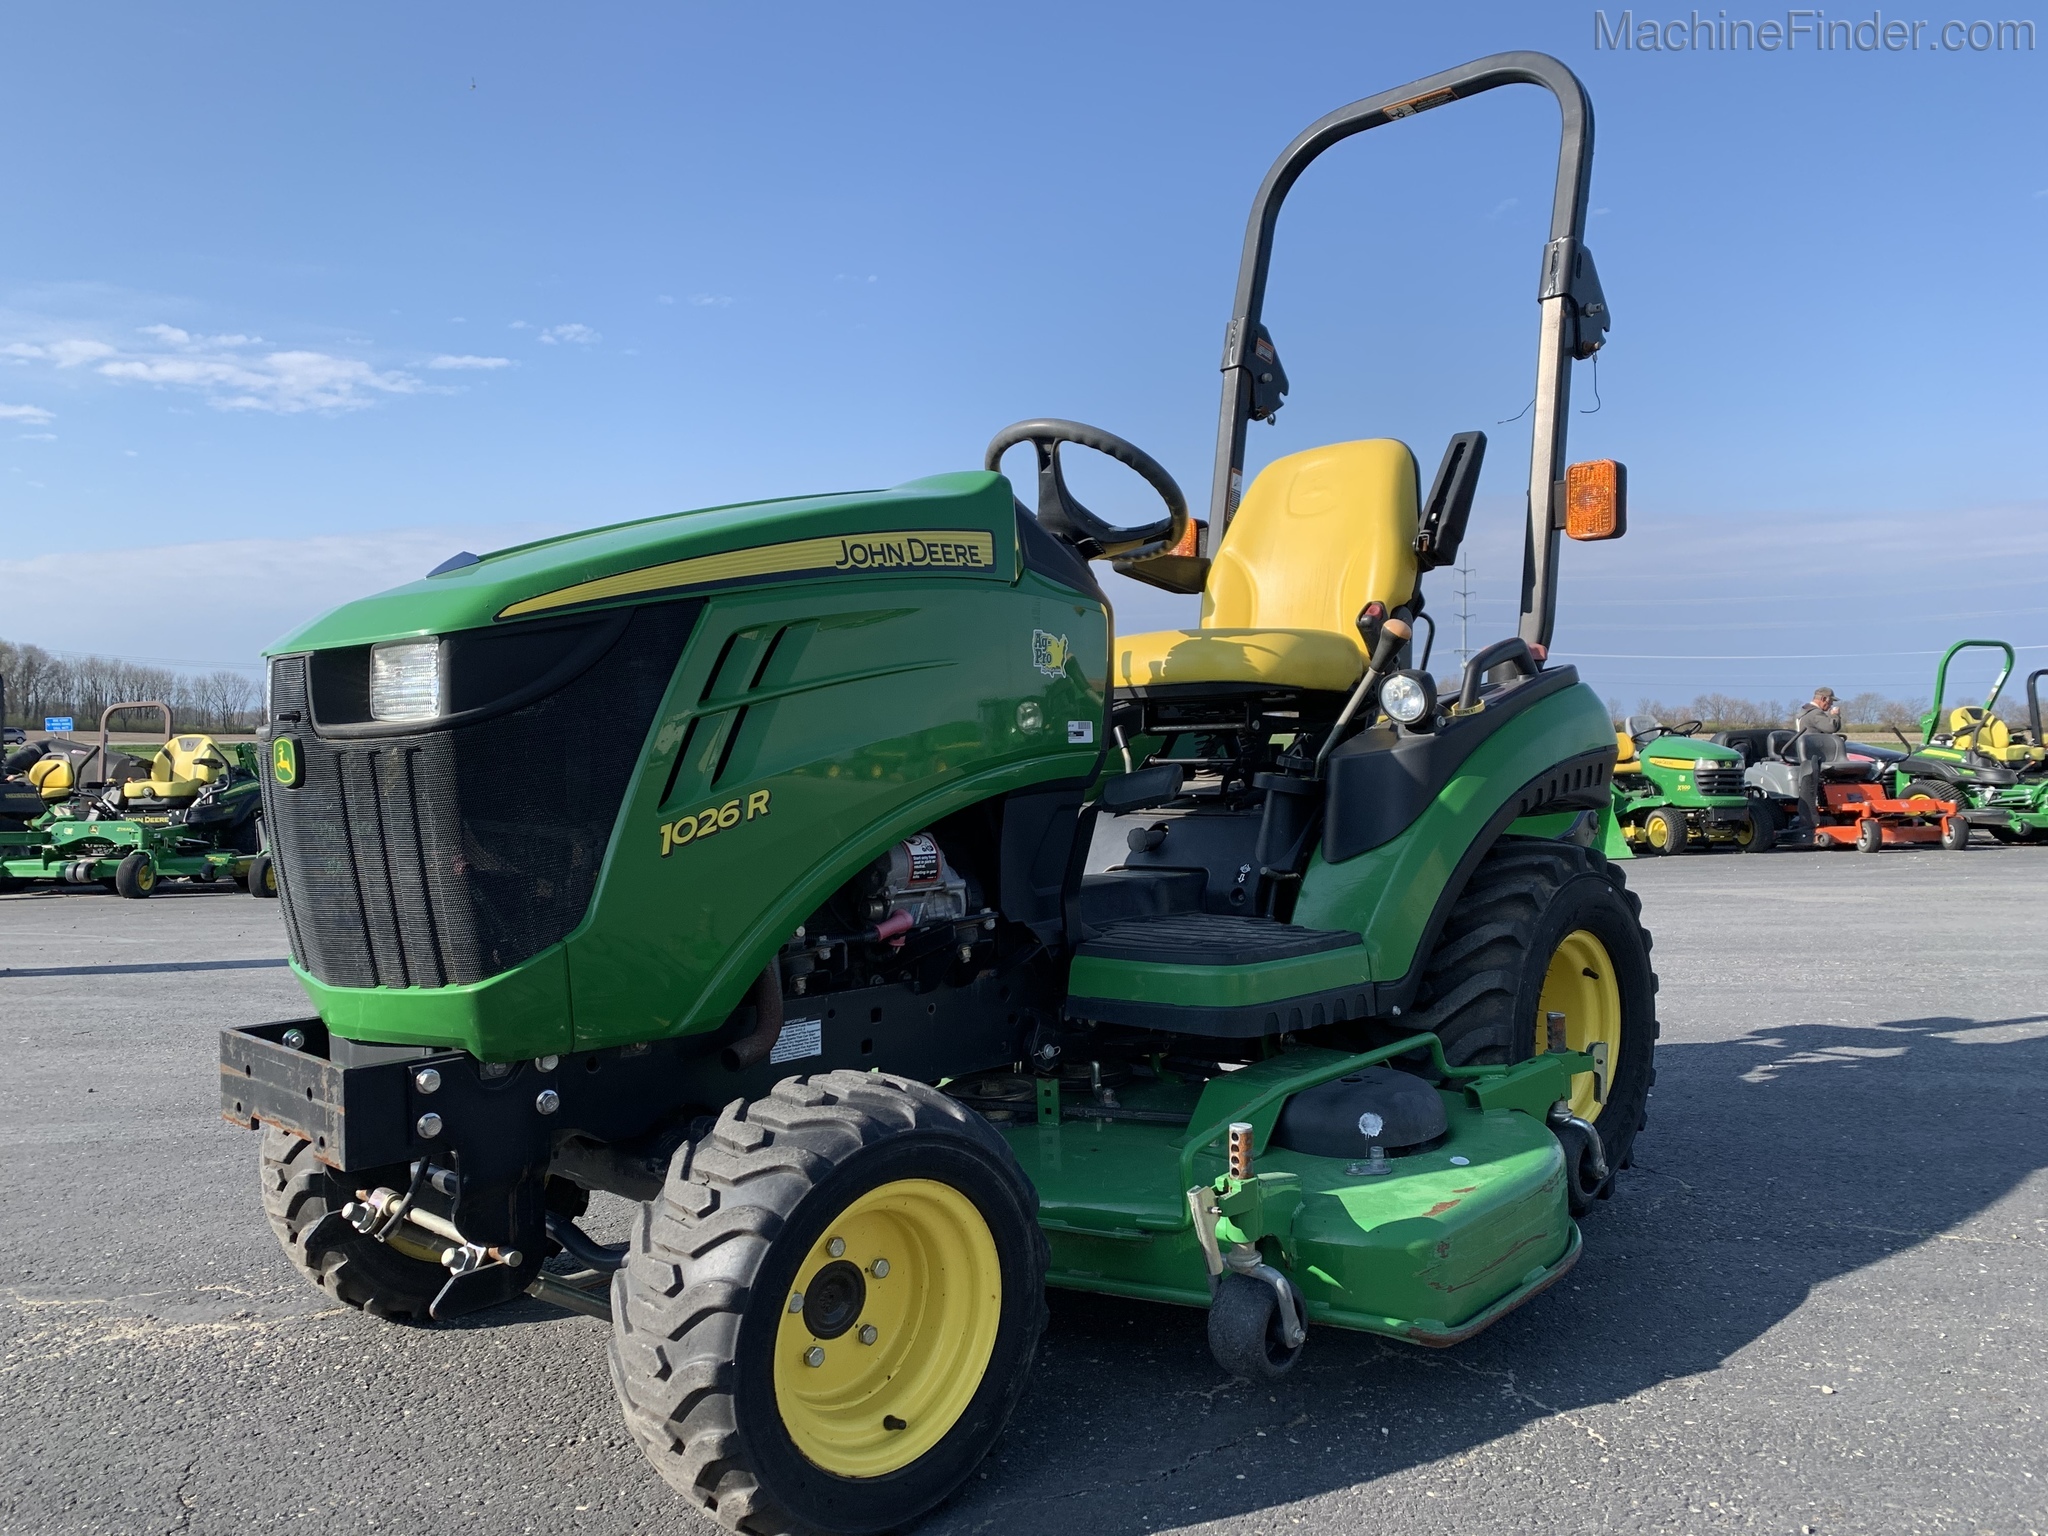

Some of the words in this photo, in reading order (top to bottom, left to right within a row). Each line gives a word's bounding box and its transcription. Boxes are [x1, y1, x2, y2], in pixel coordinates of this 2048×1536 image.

[835, 540, 905, 568] JOHN
[907, 538, 985, 567] DEERE
[660, 799, 742, 858] 1026
